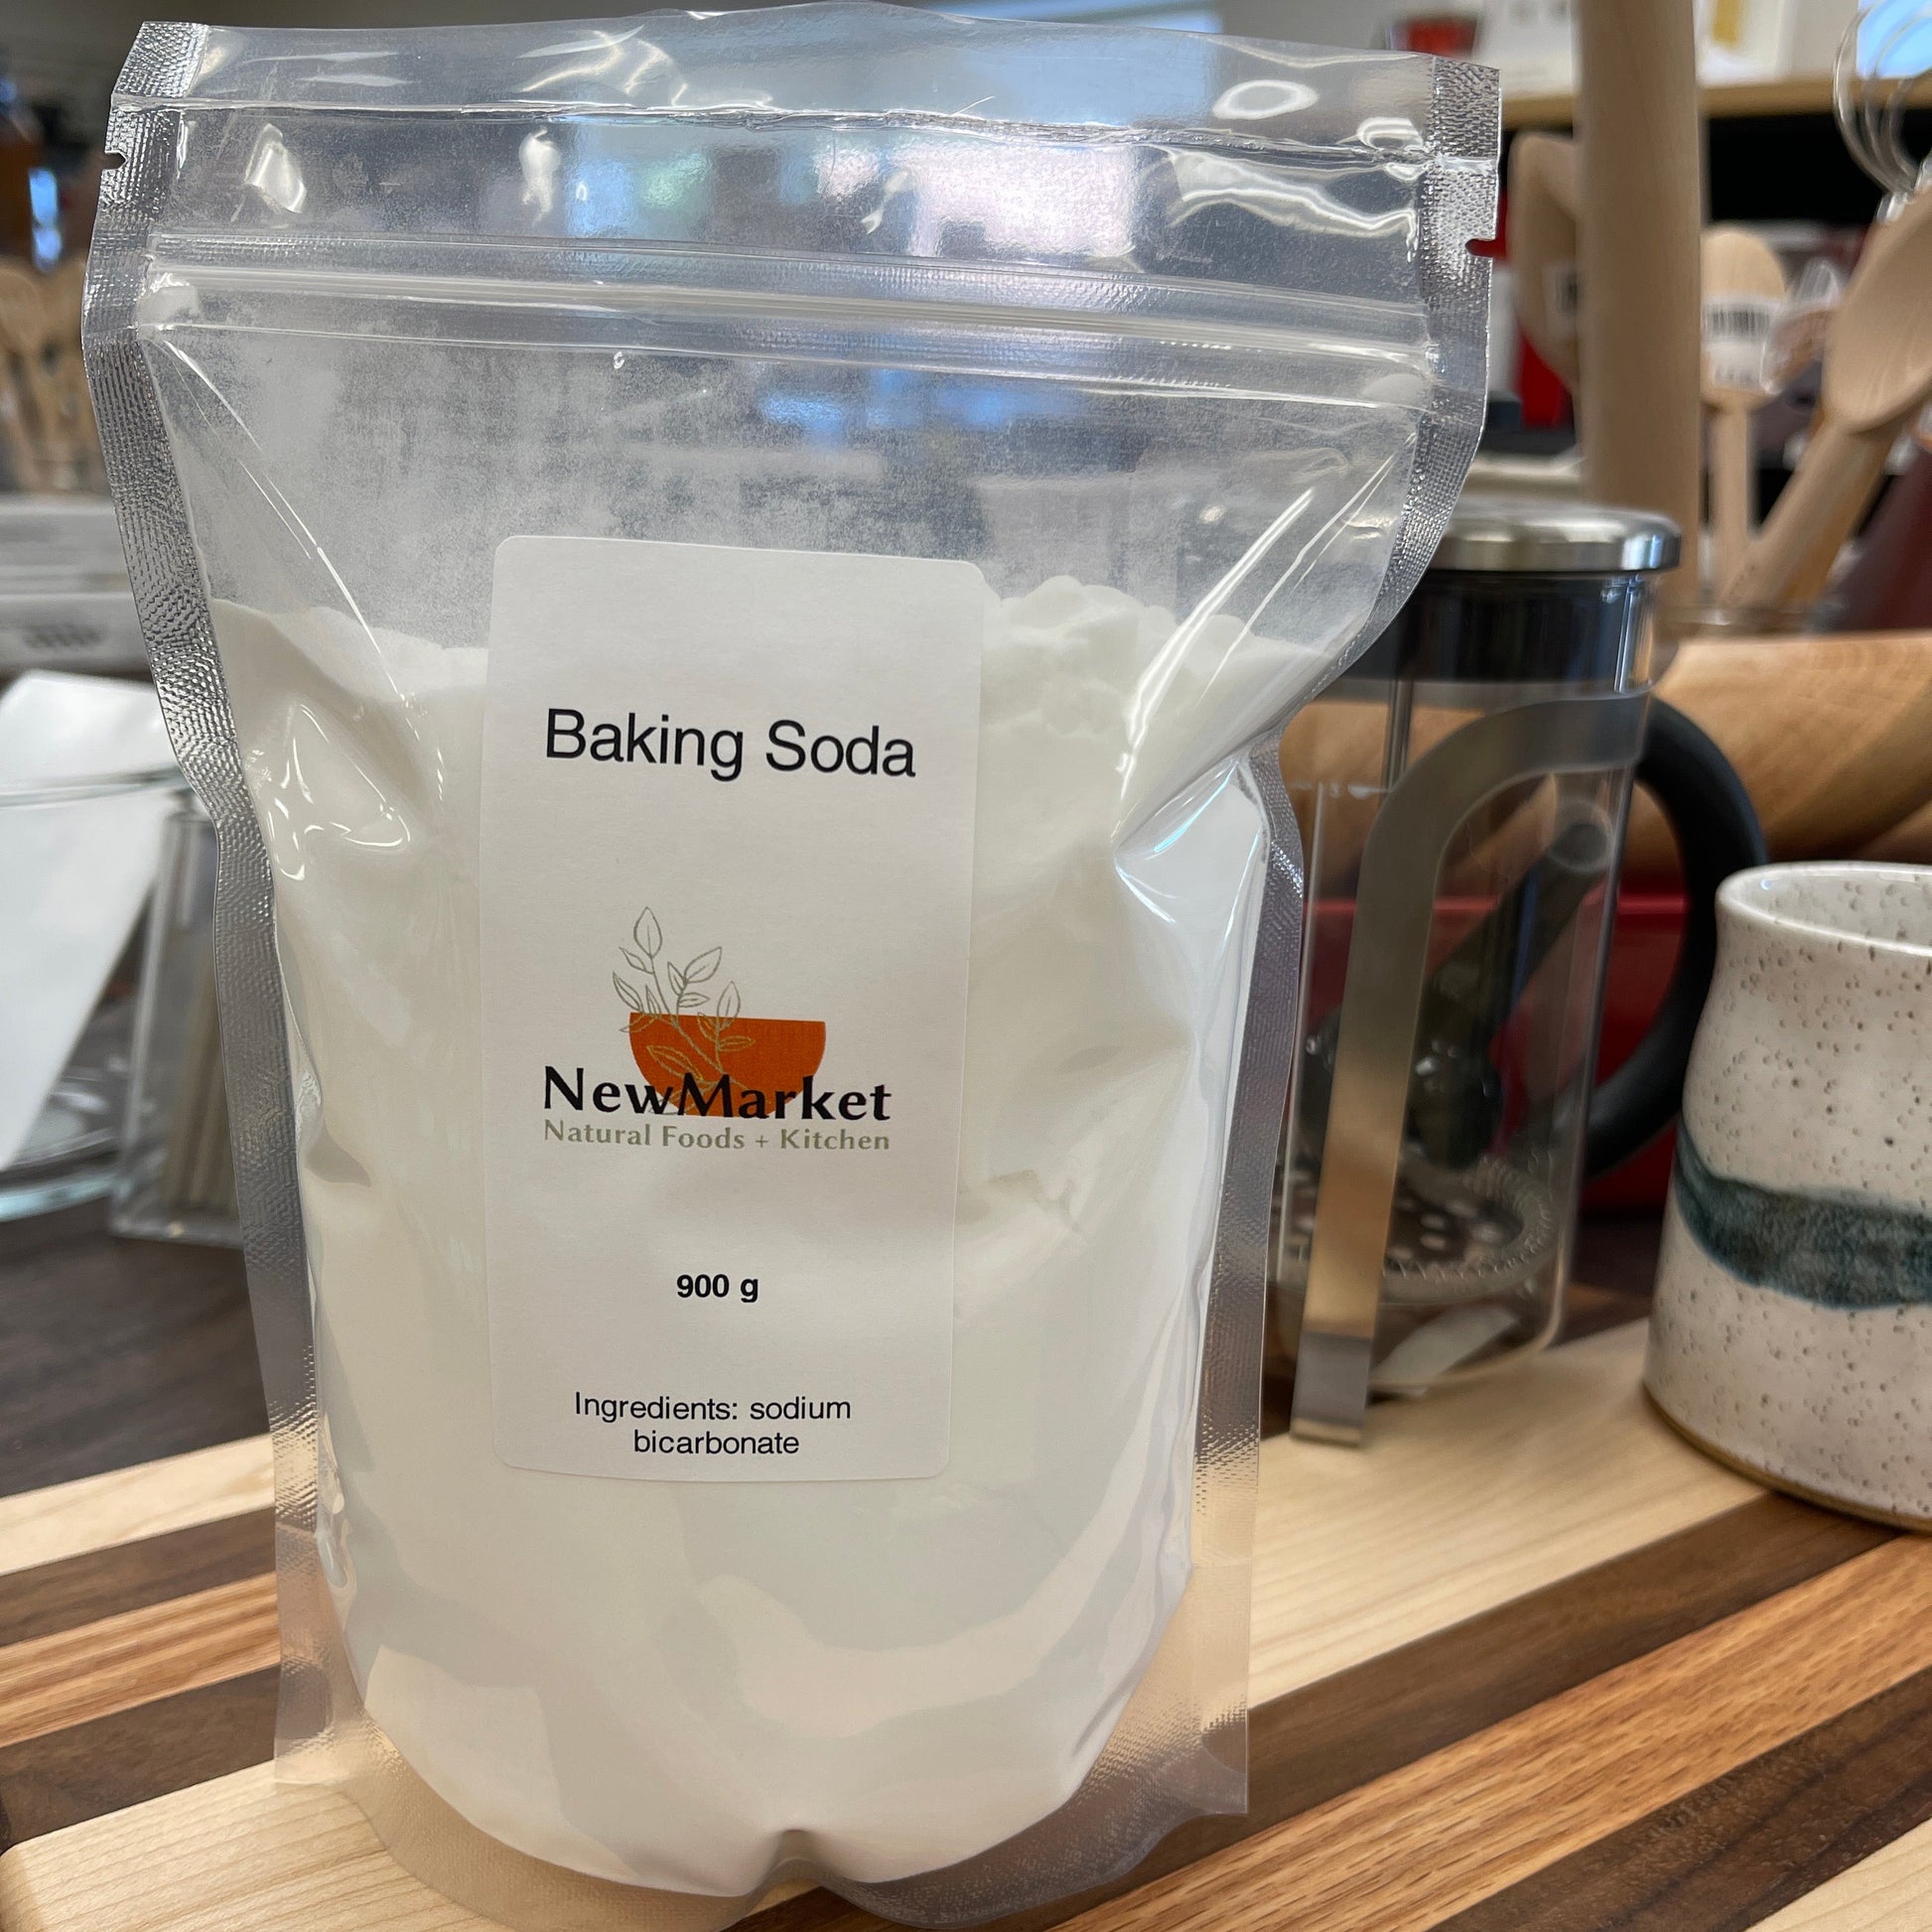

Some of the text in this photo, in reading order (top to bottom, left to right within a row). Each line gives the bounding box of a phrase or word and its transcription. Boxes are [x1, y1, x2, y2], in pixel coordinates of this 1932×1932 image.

[546, 708, 916, 782] Baking Soda
[544, 1065, 892, 1121] NewMarket
[544, 1119, 890, 1151] Natural Foods + Kitchen
[676, 1274, 759, 1304] 900 g
[575, 1391, 852, 1424] Ingredients: sodium
[633, 1429, 800, 1455] bicarbonate
